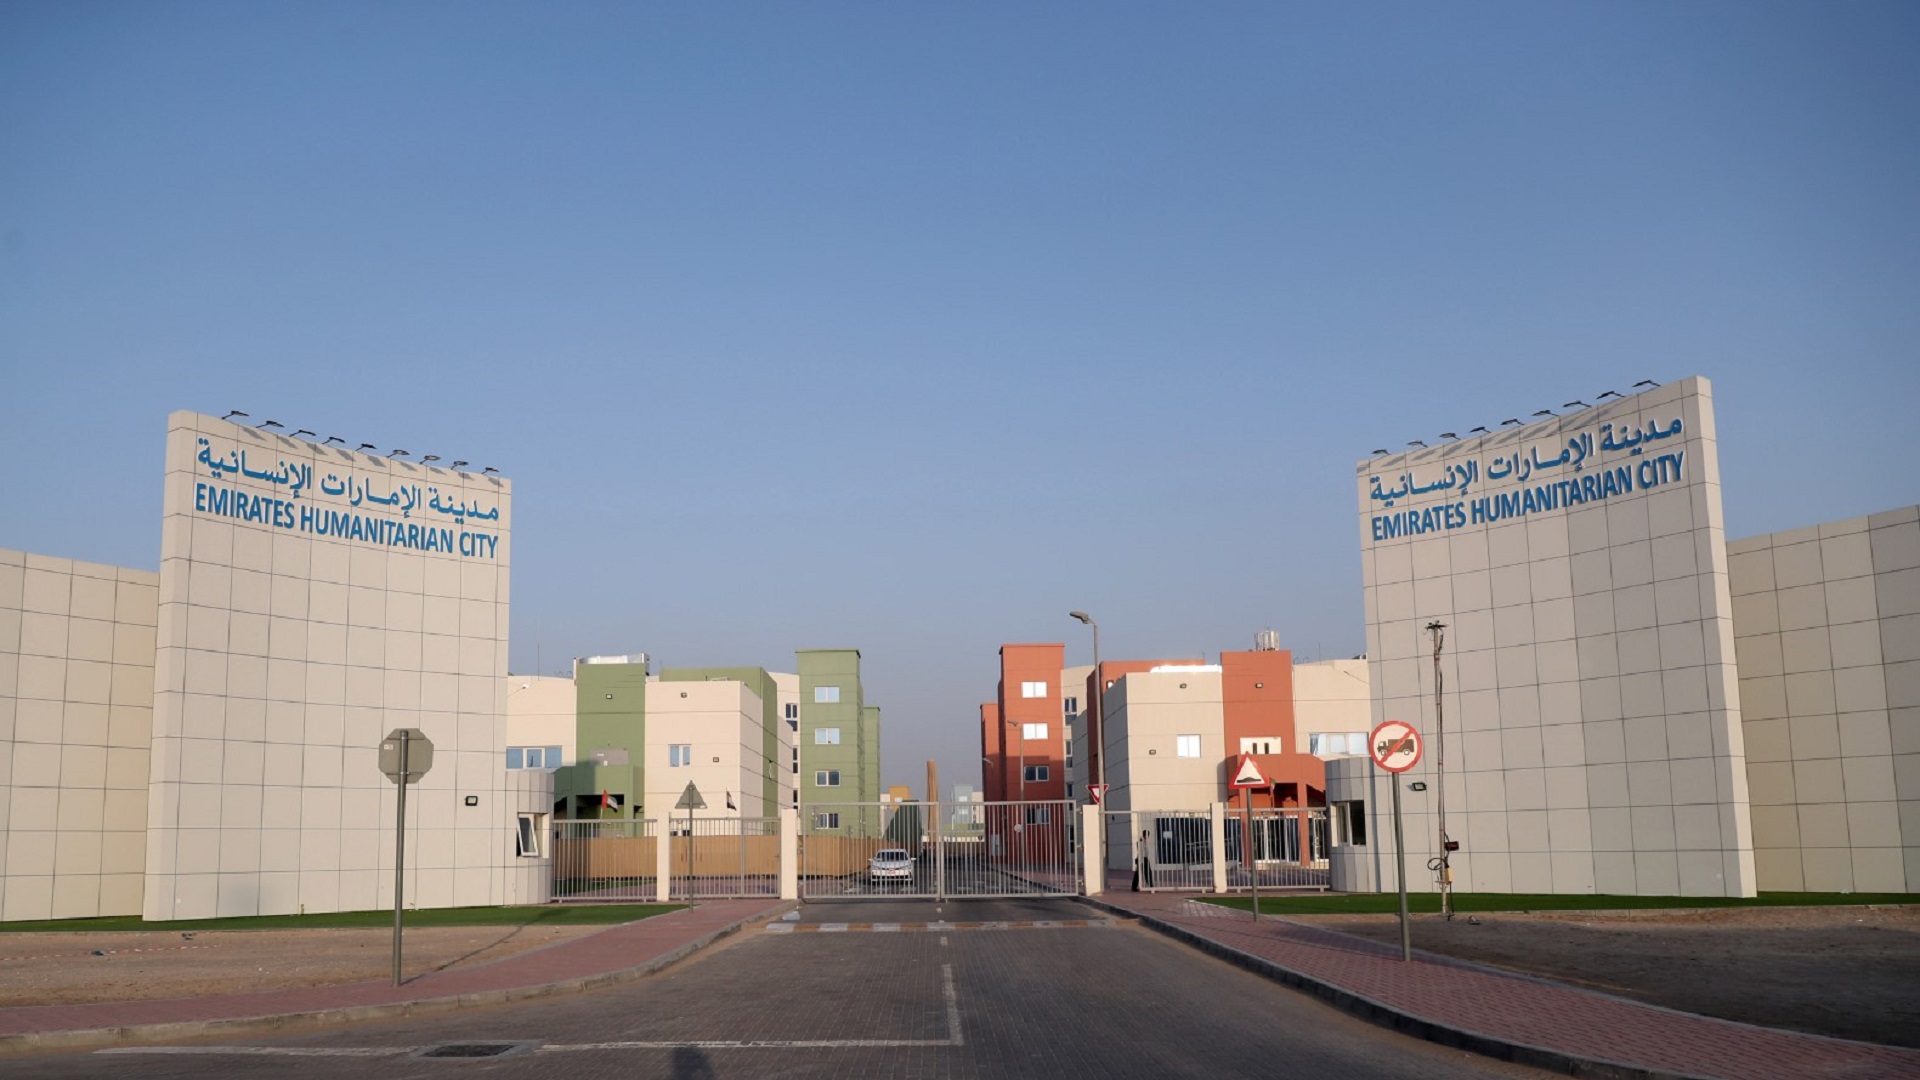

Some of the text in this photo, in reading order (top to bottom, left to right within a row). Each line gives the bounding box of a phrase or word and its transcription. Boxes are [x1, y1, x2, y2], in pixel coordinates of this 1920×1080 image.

[197, 437, 499, 524] مدينة الإمارات الإنسانية
[1370, 417, 1683, 507] مدينة الإمارات الإنسانية
[1371, 451, 1684, 541] EMIRATES HUMANITARIAN CITY
[195, 482, 498, 559] EMIRATES HUMANITARIAN CITY
